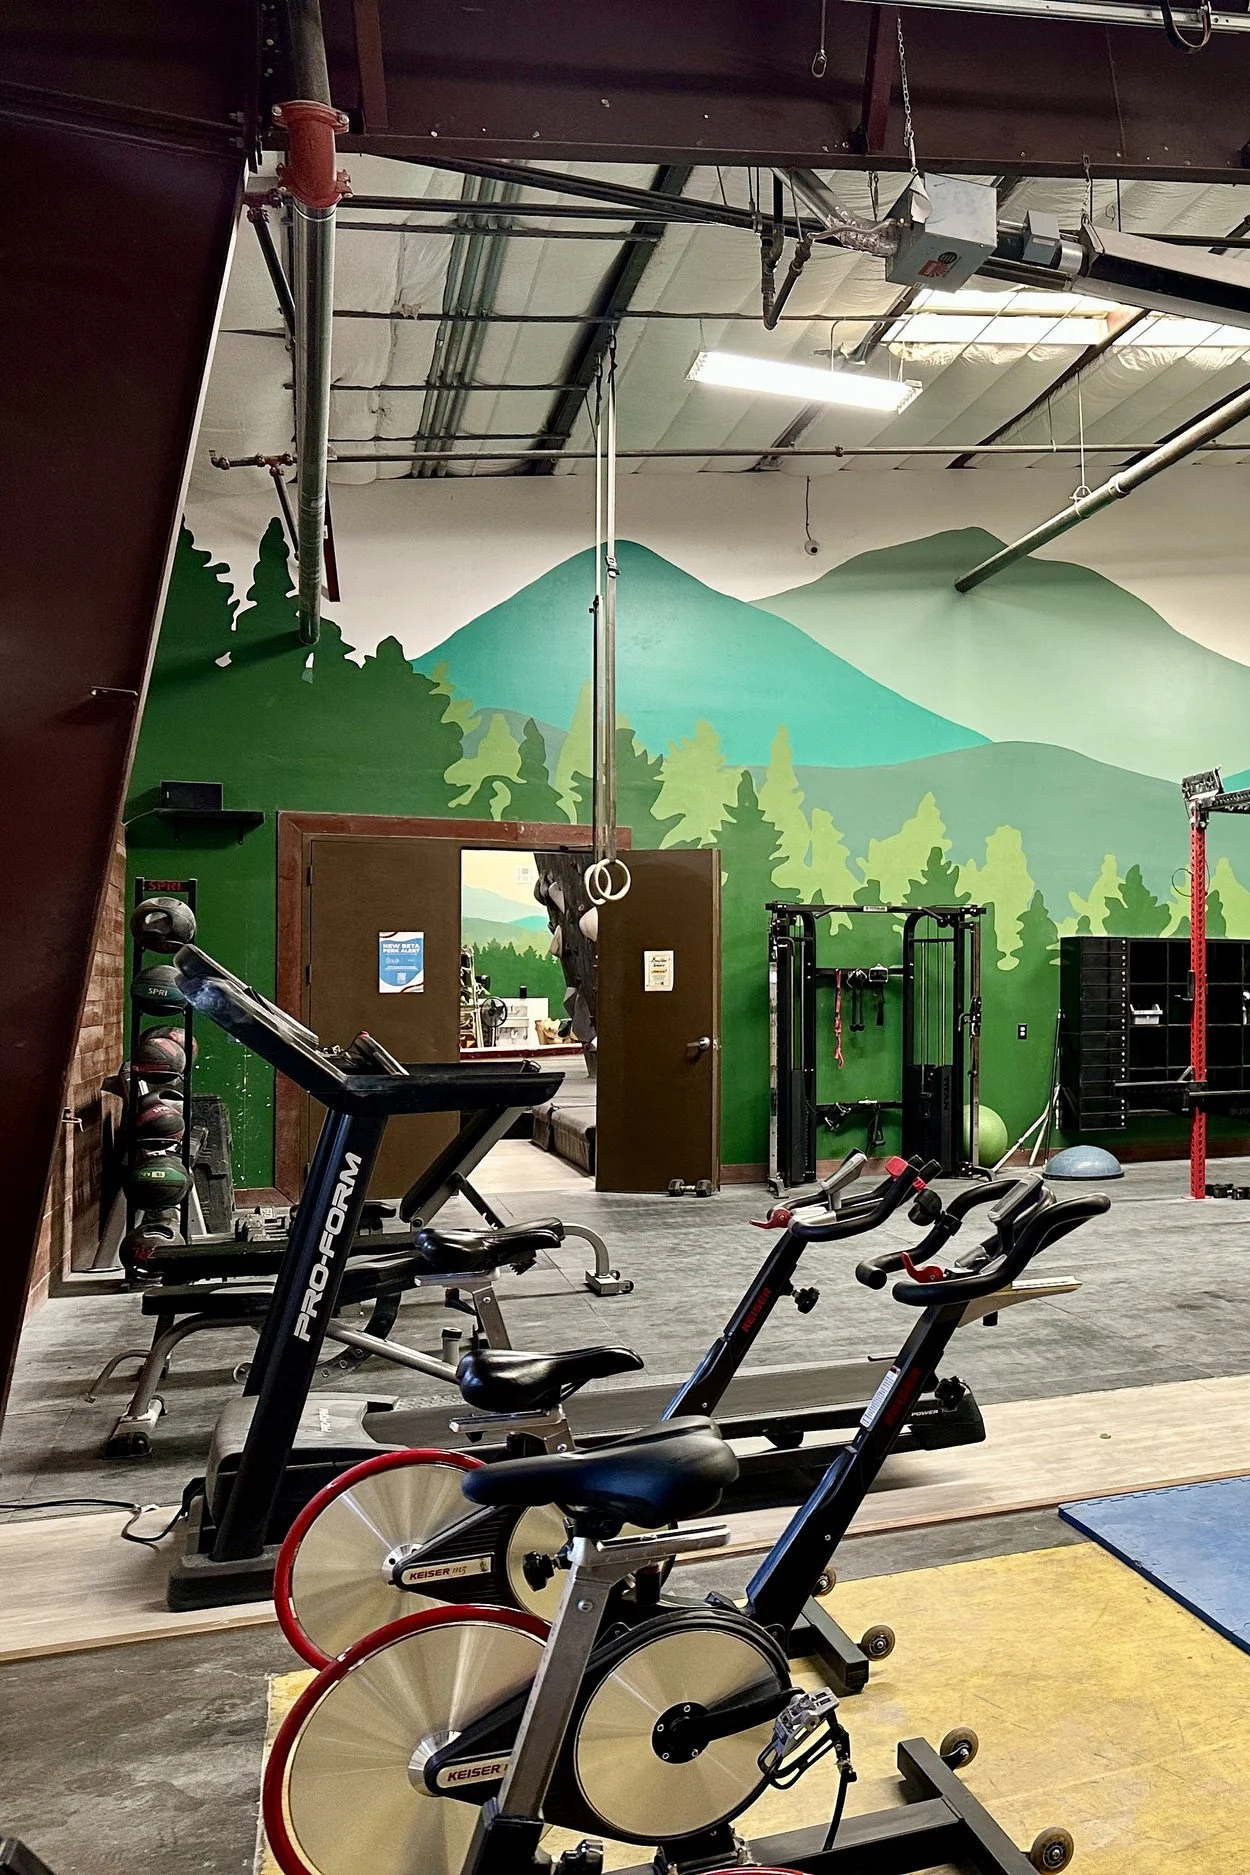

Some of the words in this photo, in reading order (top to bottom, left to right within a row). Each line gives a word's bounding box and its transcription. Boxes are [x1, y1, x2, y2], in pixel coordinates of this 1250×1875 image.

[148, 987, 168, 997] SPRI
[293, 1151, 362, 1342] PRO-FORM
[742, 1287, 772, 1333] KEISER
[911, 1409, 939, 1417] POWER
[409, 1568, 451, 1581] KEISER
[447, 1764, 501, 1782] KEISER
